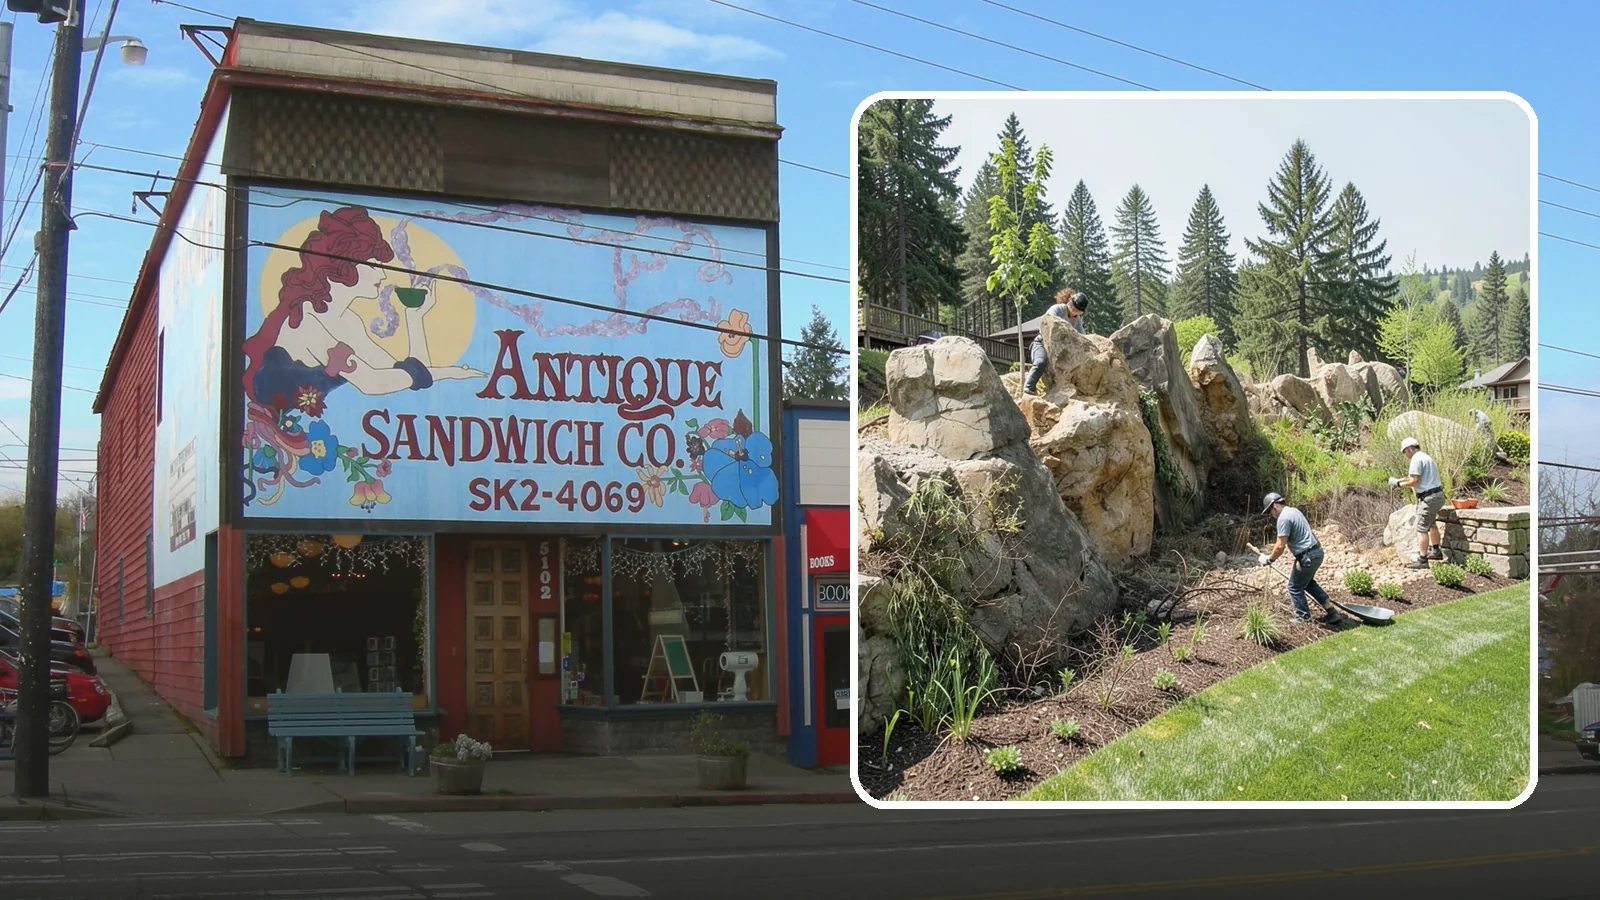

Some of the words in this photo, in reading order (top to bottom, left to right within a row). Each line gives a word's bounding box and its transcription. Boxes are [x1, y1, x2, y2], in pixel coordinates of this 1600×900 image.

[477, 328, 724, 421] ANTIQUE
[362, 408, 605, 467] SANDWICH
[617, 421, 685, 468] CO.
[468, 477, 646, 513] SK2-4069
[540, 541, 552, 600] 5102
[809, 554, 834, 569] BOOKS
